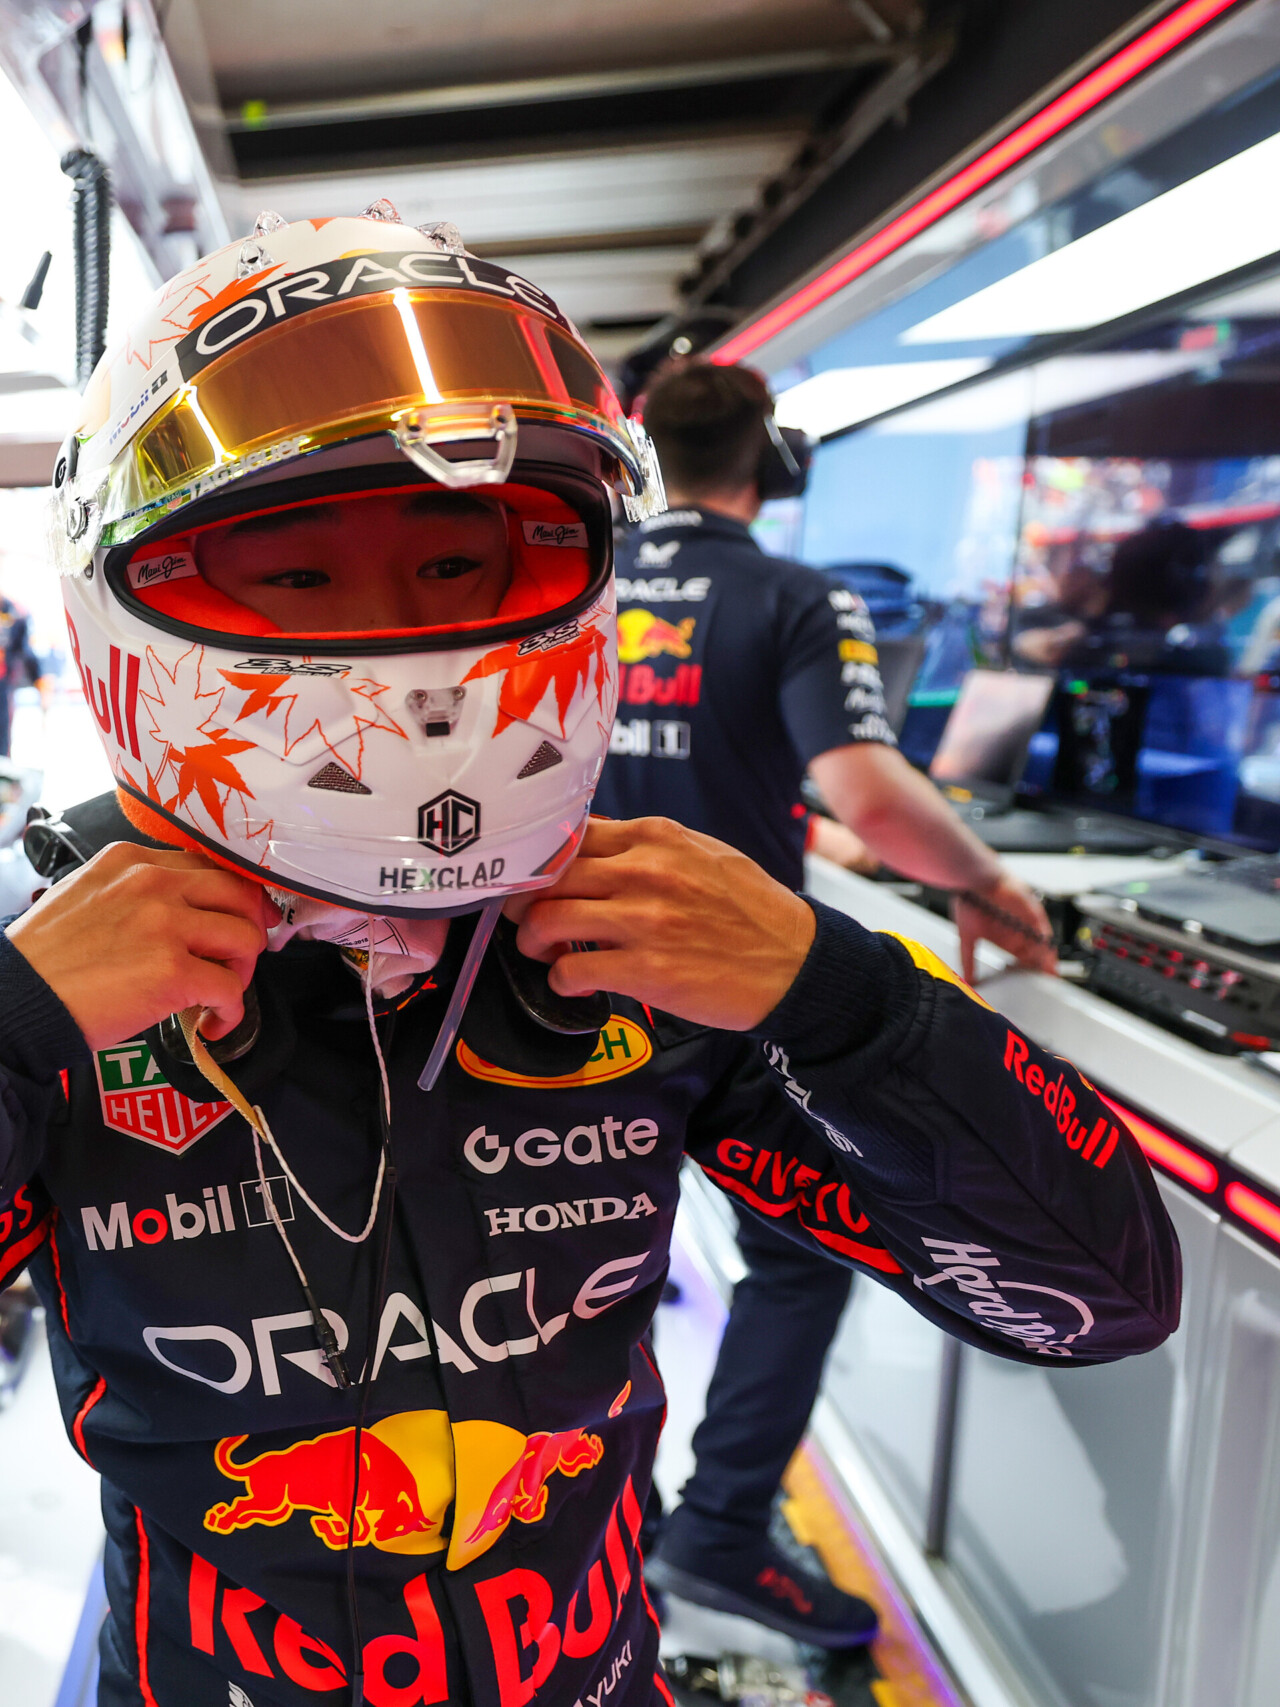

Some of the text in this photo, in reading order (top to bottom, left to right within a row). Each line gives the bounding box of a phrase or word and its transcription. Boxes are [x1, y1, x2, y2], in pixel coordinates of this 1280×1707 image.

[195, 253, 559, 357] ORACLE
[137, 556, 187, 583] Maui Jim
[616, 576, 713, 602] RACLE
[626, 663, 703, 708] Bull
[608, 719, 651, 757] bil
[378, 857, 506, 893] HEXCLAD
[110, 1091, 231, 1144] HEUE
[1003, 1028, 1120, 1169] Red Bull
[514, 1115, 660, 1167] Gate
[80, 1184, 236, 1251] Mobil
[483, 1191, 658, 1237] HONDA
[142, 1250, 652, 1397] ORACLE
[188, 1474, 643, 1707] Red Bull
[585, 1639, 633, 1707] YUKI
